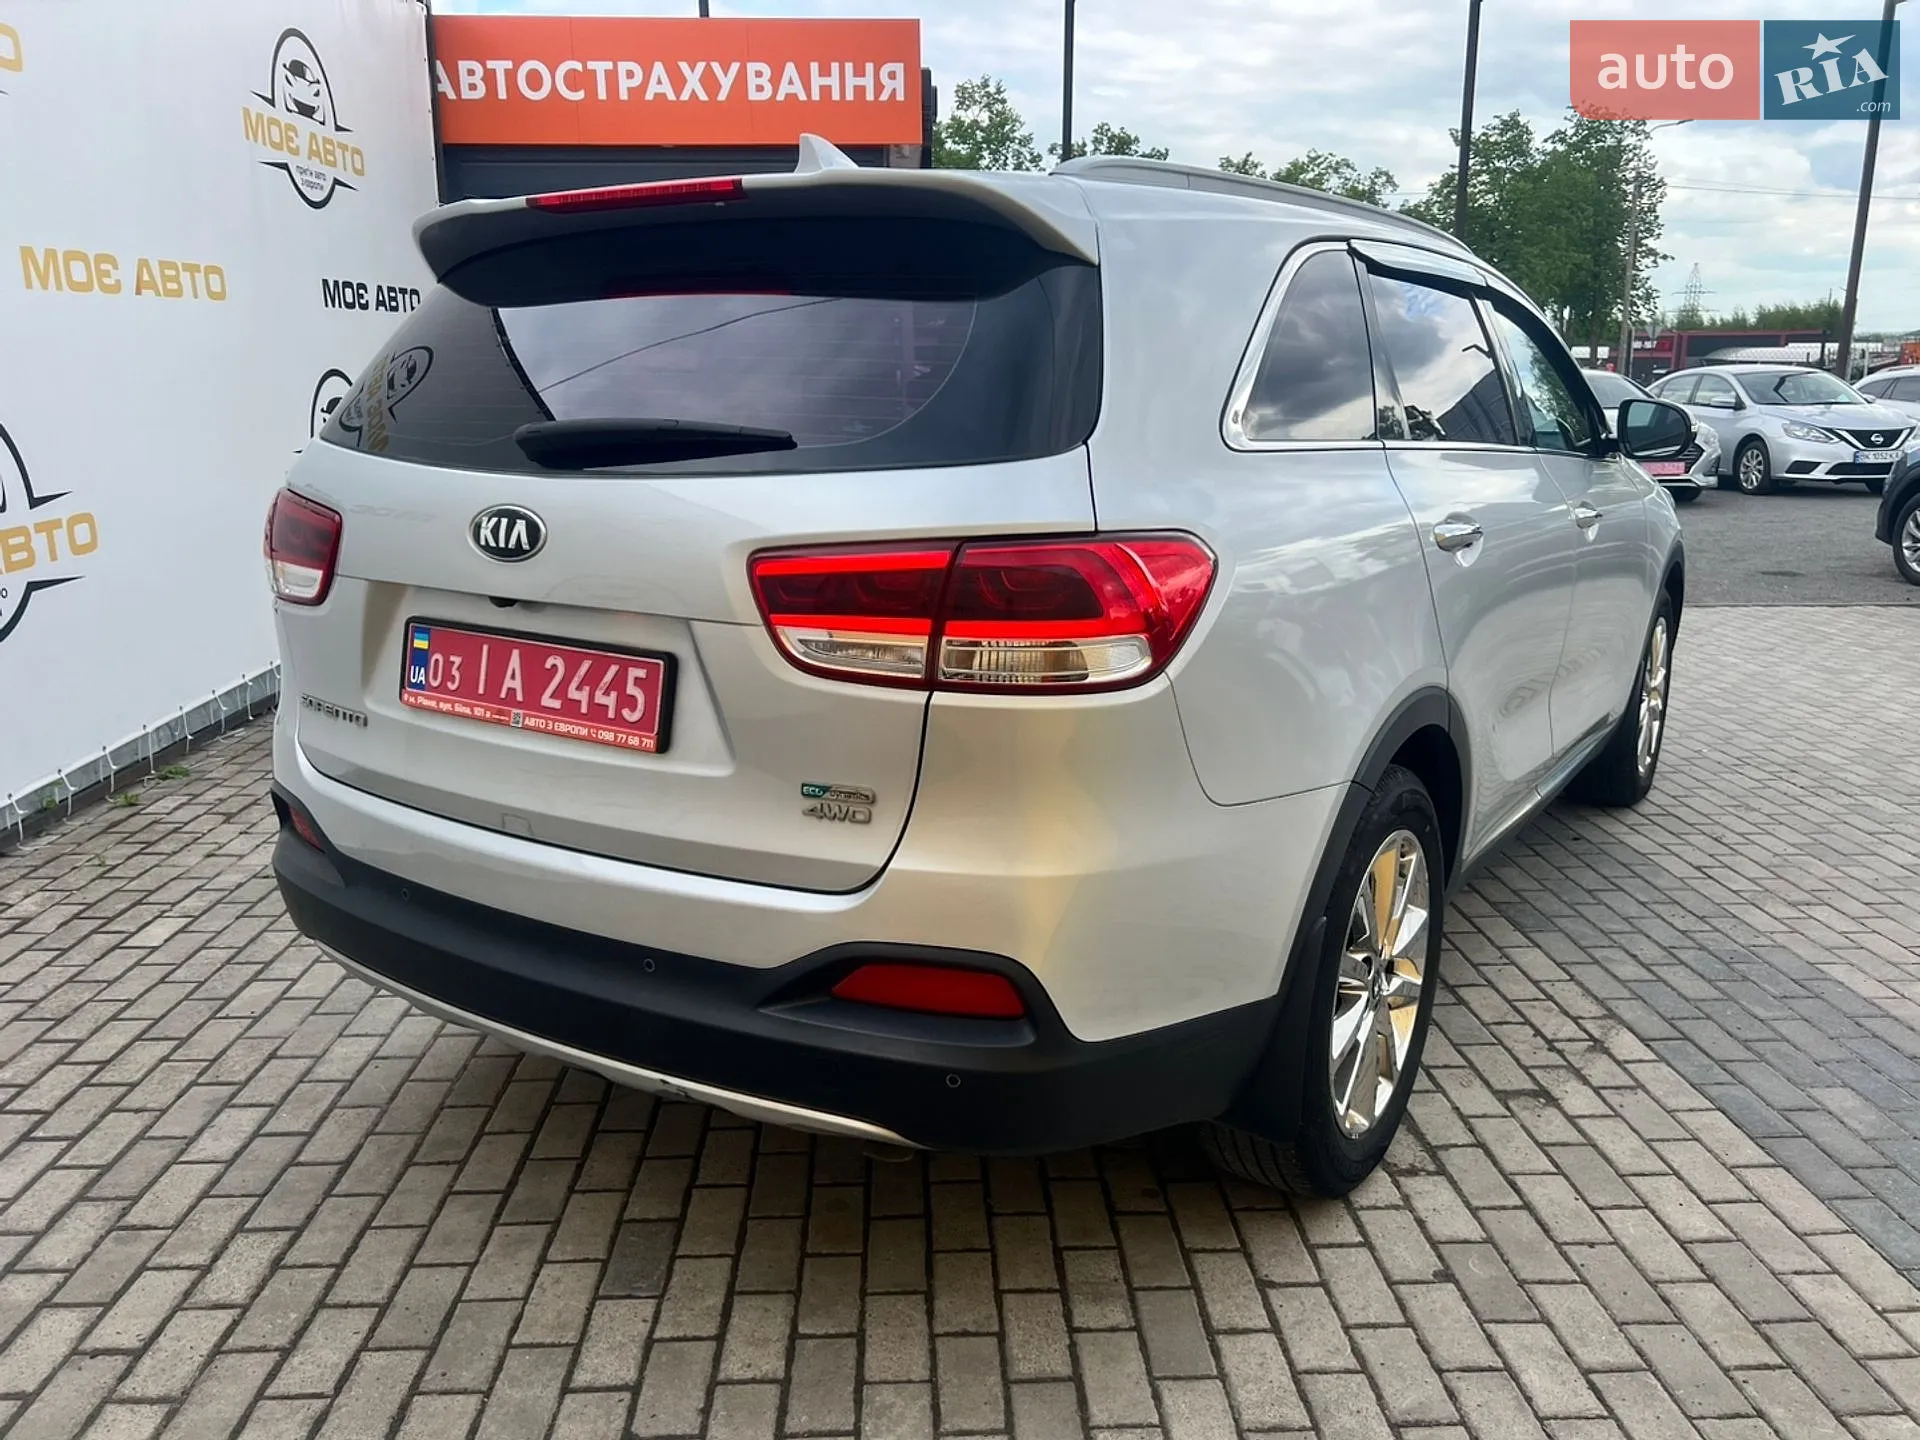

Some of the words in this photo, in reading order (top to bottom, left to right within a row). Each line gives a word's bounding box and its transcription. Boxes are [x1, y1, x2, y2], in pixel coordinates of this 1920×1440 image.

[436, 59, 906, 102] АВТОСТРАХУВАННЯ
[242, 106, 300, 157] МОЄ
[308, 131, 366, 177] АВТО
[19, 246, 122, 294] МОЄ
[135, 258, 227, 301] АВТО
[321, 278, 369, 310] МОЄ
[375, 284, 420, 313] АВТО
[0, 512, 98, 575] ВТО
[480, 516, 531, 551] KIA
[410, 665, 426, 685] UA
[428, 652, 461, 691] 03
[540, 654, 648, 723] 2445
[523, 716, 546, 728] АВТО
[554, 722, 588, 737] ЄВРОПИ
[598, 729, 615, 742] 098
[615, 733, 626, 743] 77
[802, 801, 873, 824] 4WD
